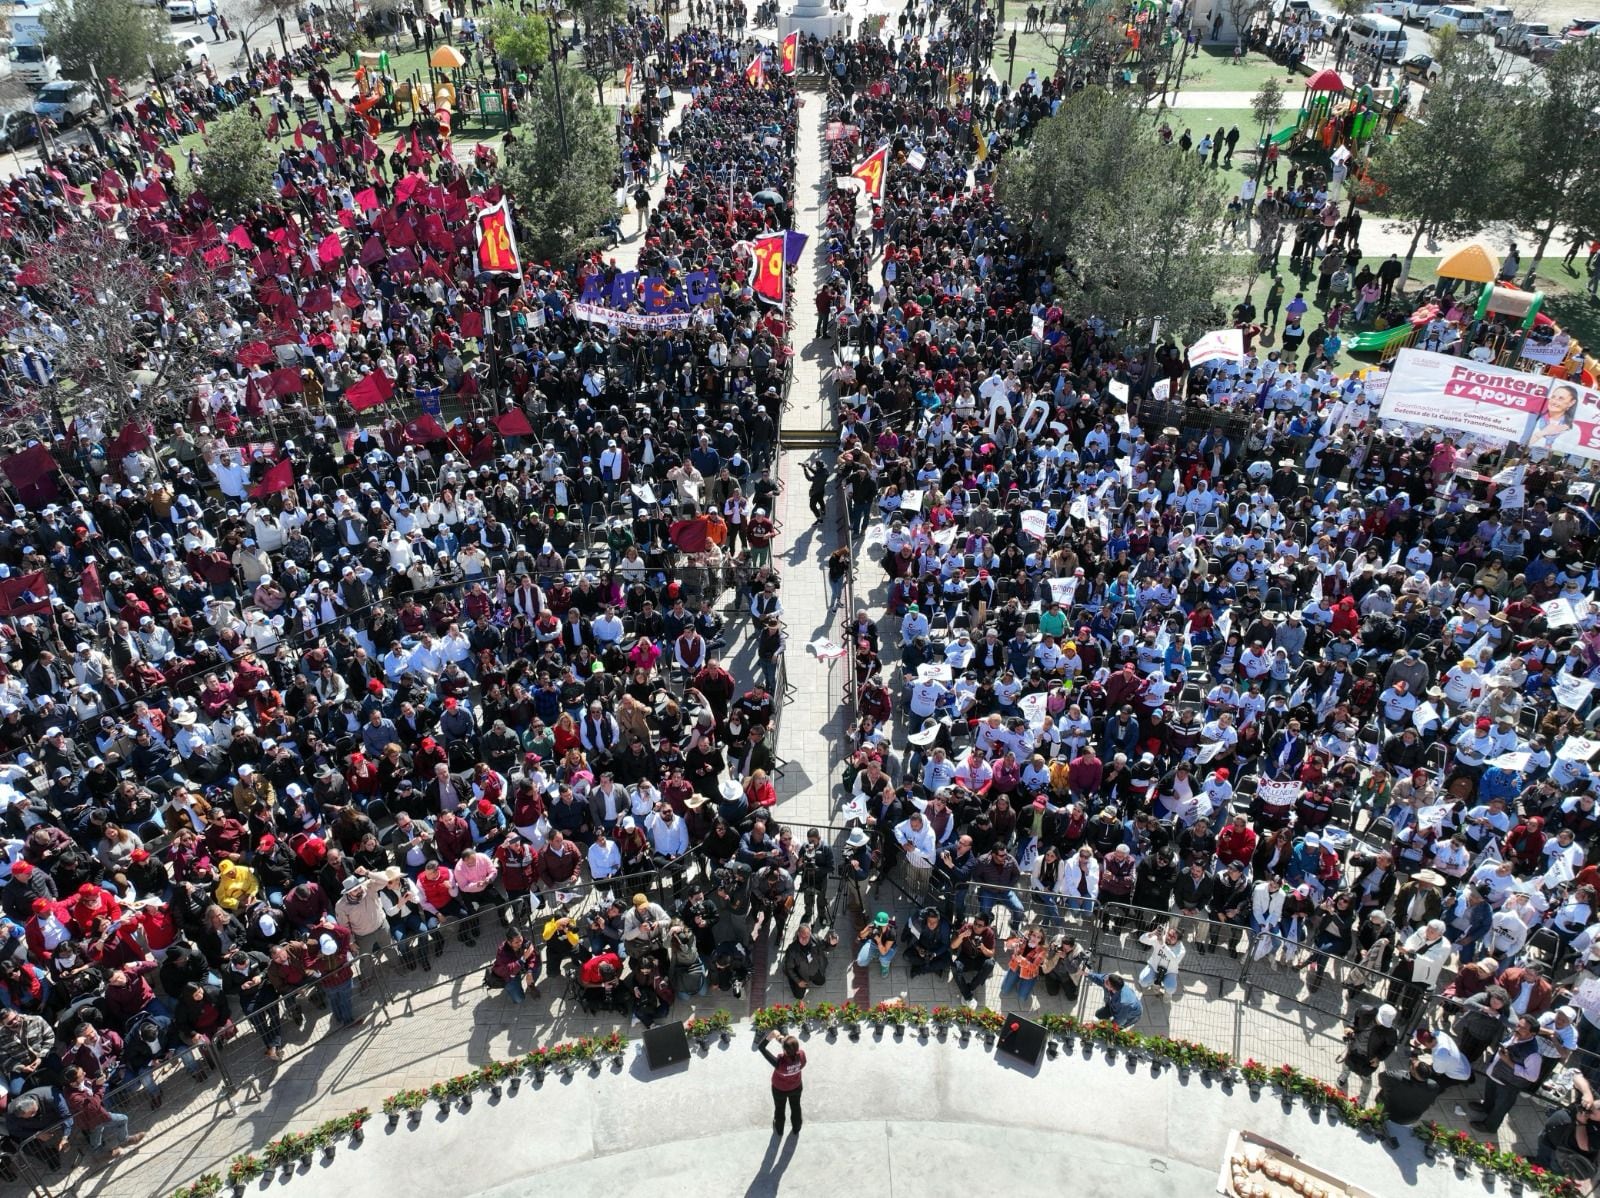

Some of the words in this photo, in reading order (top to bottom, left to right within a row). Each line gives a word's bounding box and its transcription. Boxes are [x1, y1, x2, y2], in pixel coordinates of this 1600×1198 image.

[576, 304, 593, 313] CON
[595, 308, 605, 316] LA
[630, 315, 665, 324] CLAUDIA
[1451, 365, 1548, 397] Frontera
[1452, 384, 1465, 394] y
[1468, 386, 1528, 407] Apoya
[1394, 407, 1421, 416] Defensa
[1439, 414, 1462, 423] Cuarta
[1463, 418, 1517, 435] Transformación
[1463, 412, 1491, 423] Comités
